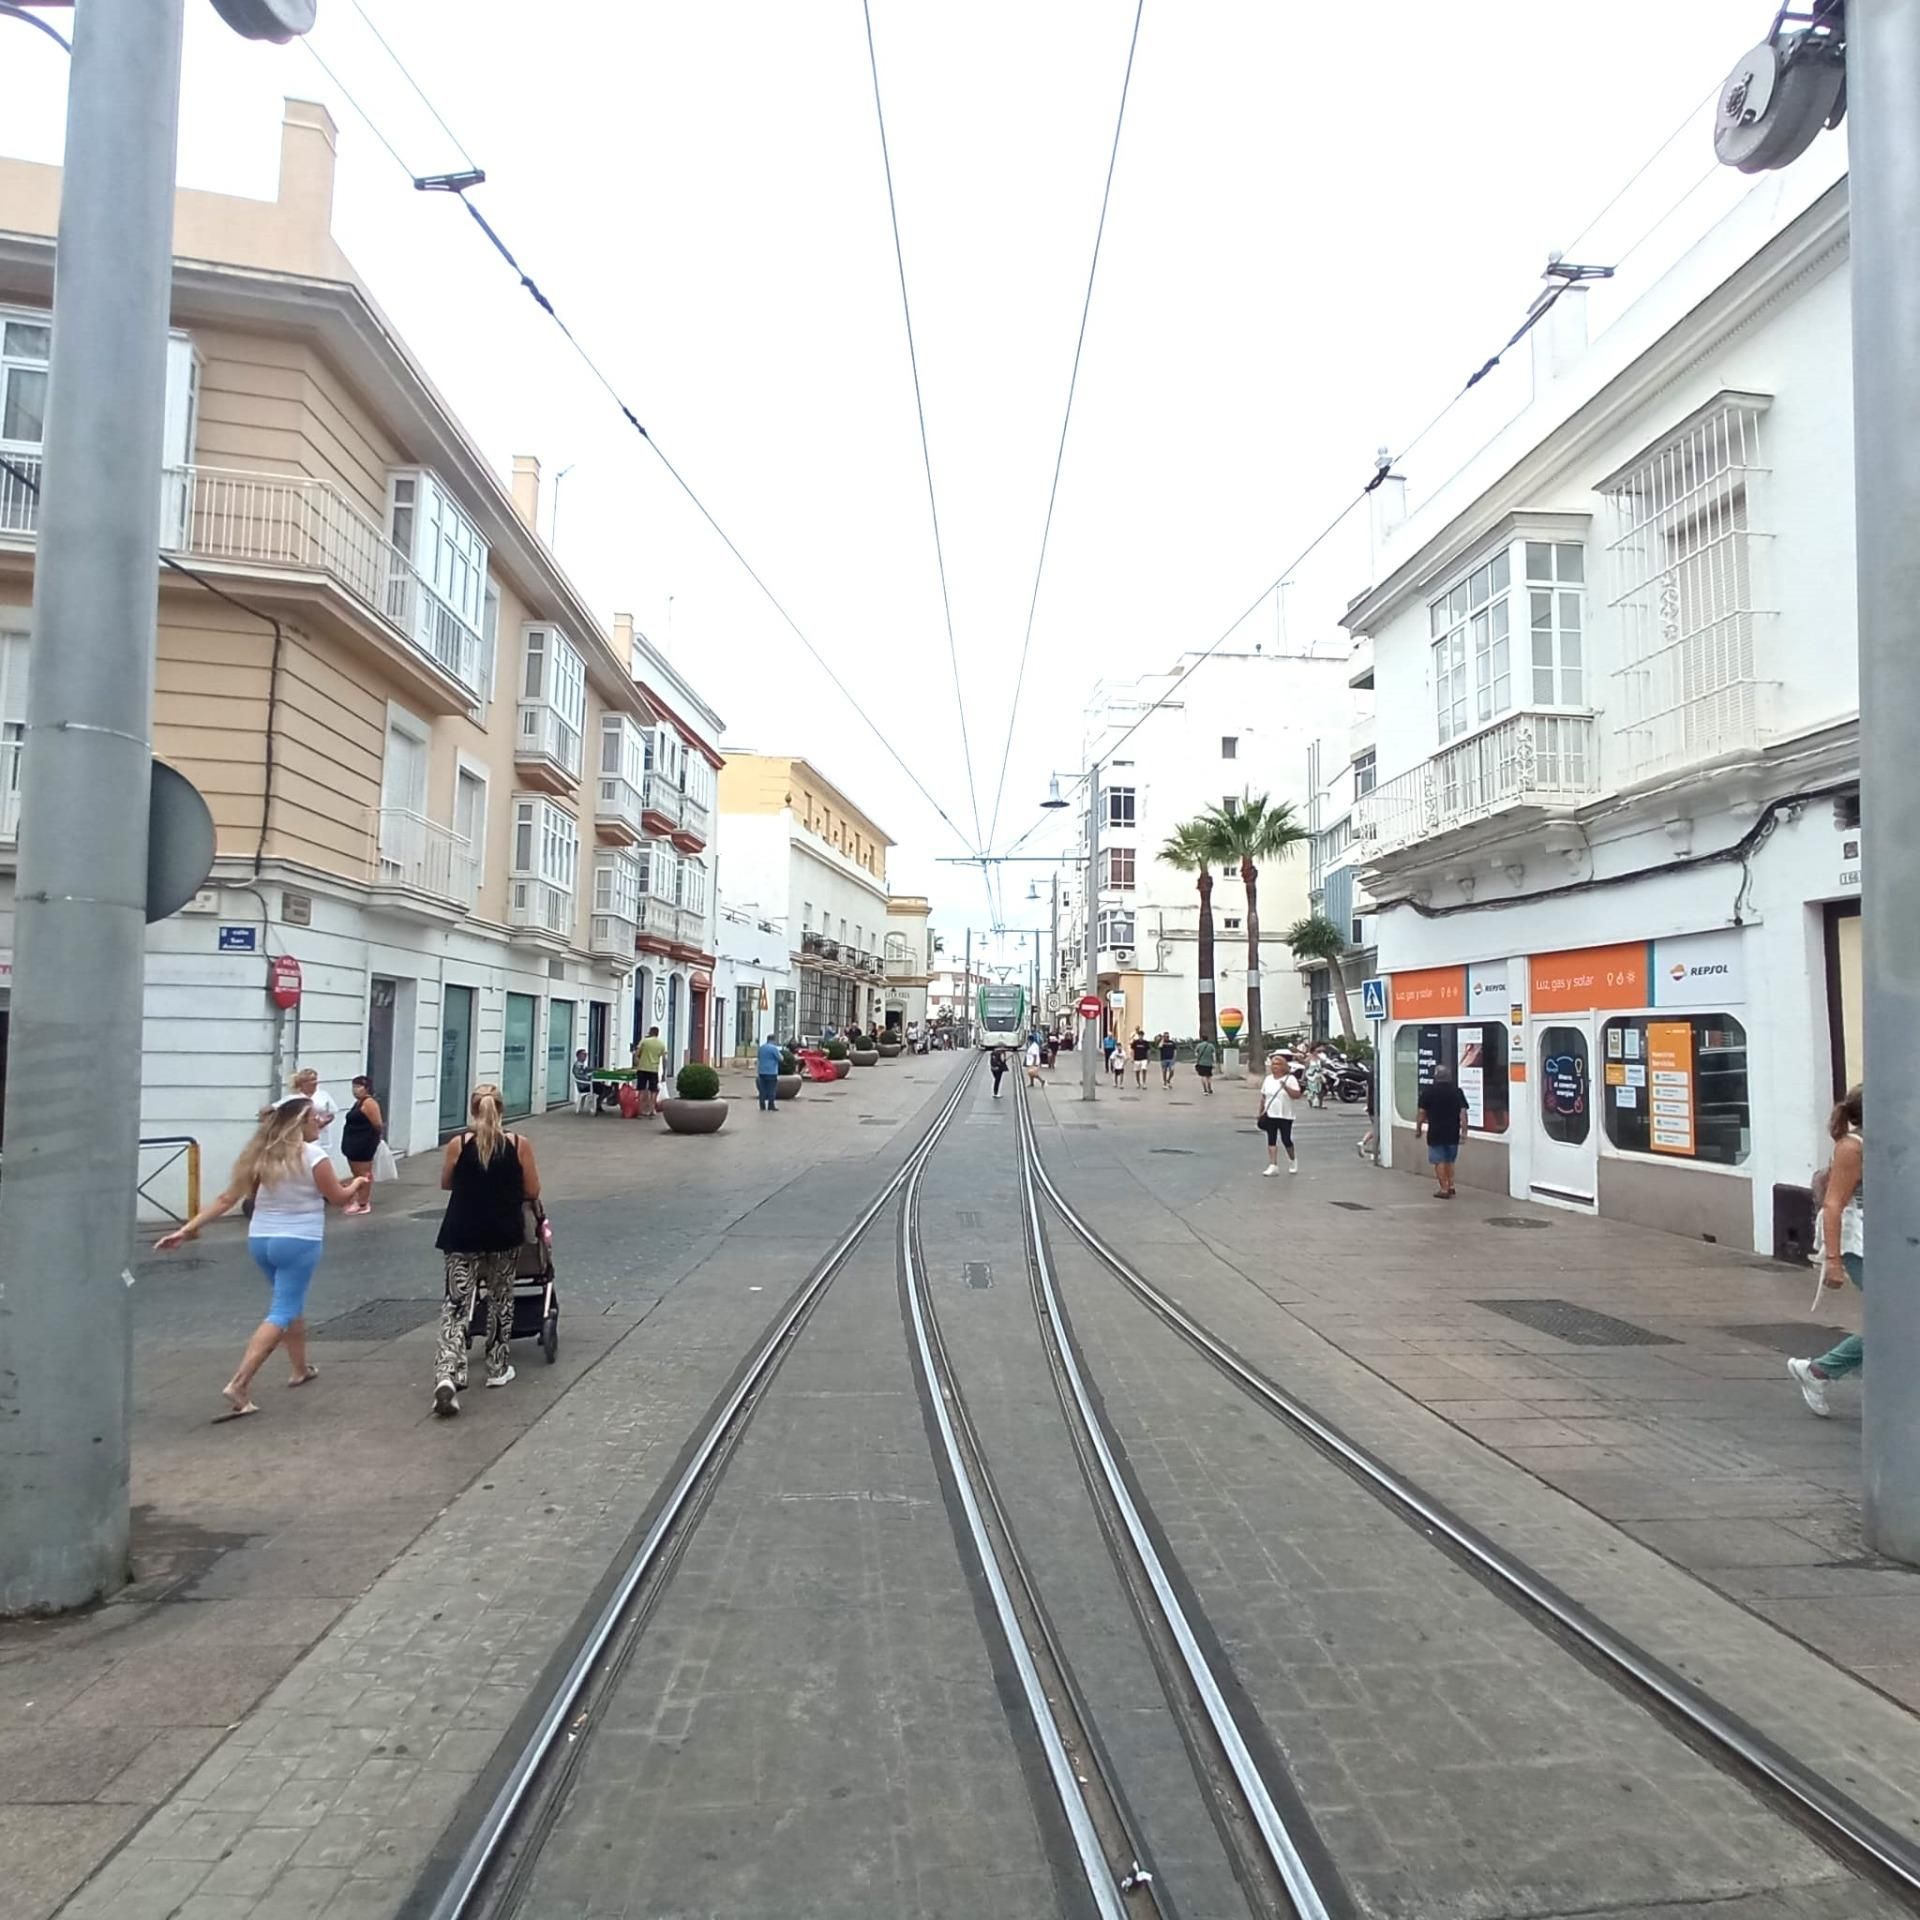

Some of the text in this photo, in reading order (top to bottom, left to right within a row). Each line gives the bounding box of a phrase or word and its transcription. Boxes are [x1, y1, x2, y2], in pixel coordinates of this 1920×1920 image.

[1690, 964, 1728, 977] REPSOL
[1485, 983, 1507, 993] REPSOL
[1551, 978, 1565, 992] gas
[1573, 974, 1594, 987] solar
